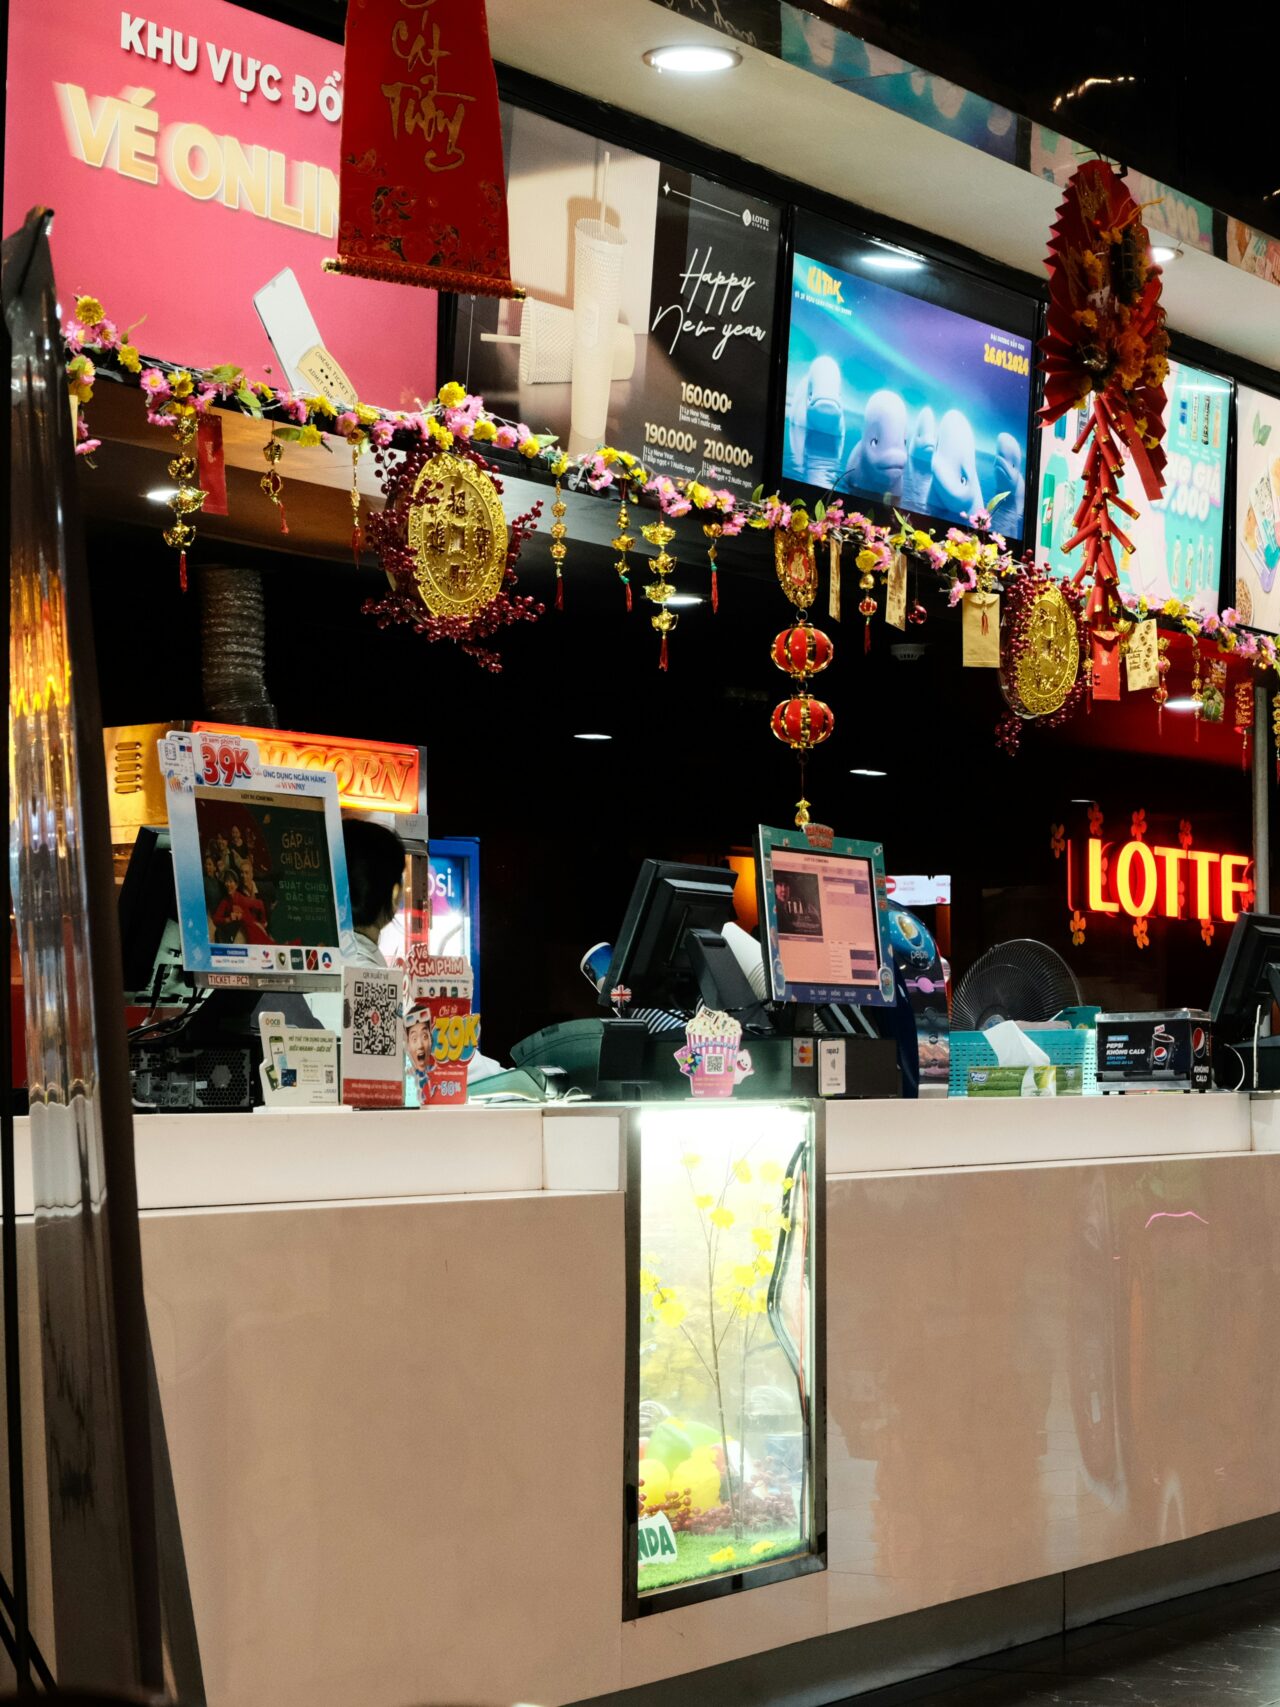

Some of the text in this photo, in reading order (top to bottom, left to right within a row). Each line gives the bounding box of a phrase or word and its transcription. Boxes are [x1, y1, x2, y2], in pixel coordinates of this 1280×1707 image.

[120, 11, 343, 122] KHU VỰC ĐỔ
[58, 83, 159, 185] VÉ
[752, 214, 769, 227] LOTTE
[679, 246, 755, 315] Happy
[651, 304, 766, 361] New year
[333, 371, 349, 395] TICKET
[201, 743, 252, 787] 39K
[1088, 838, 1249, 922] LOTTE
[410, 958, 463, 976] XEM PHIM
[416, 945, 428, 958] Vé
[911, 950, 929, 961] peps
[209, 975, 231, 986] TICKET
[434, 1014, 480, 1063] 39K
